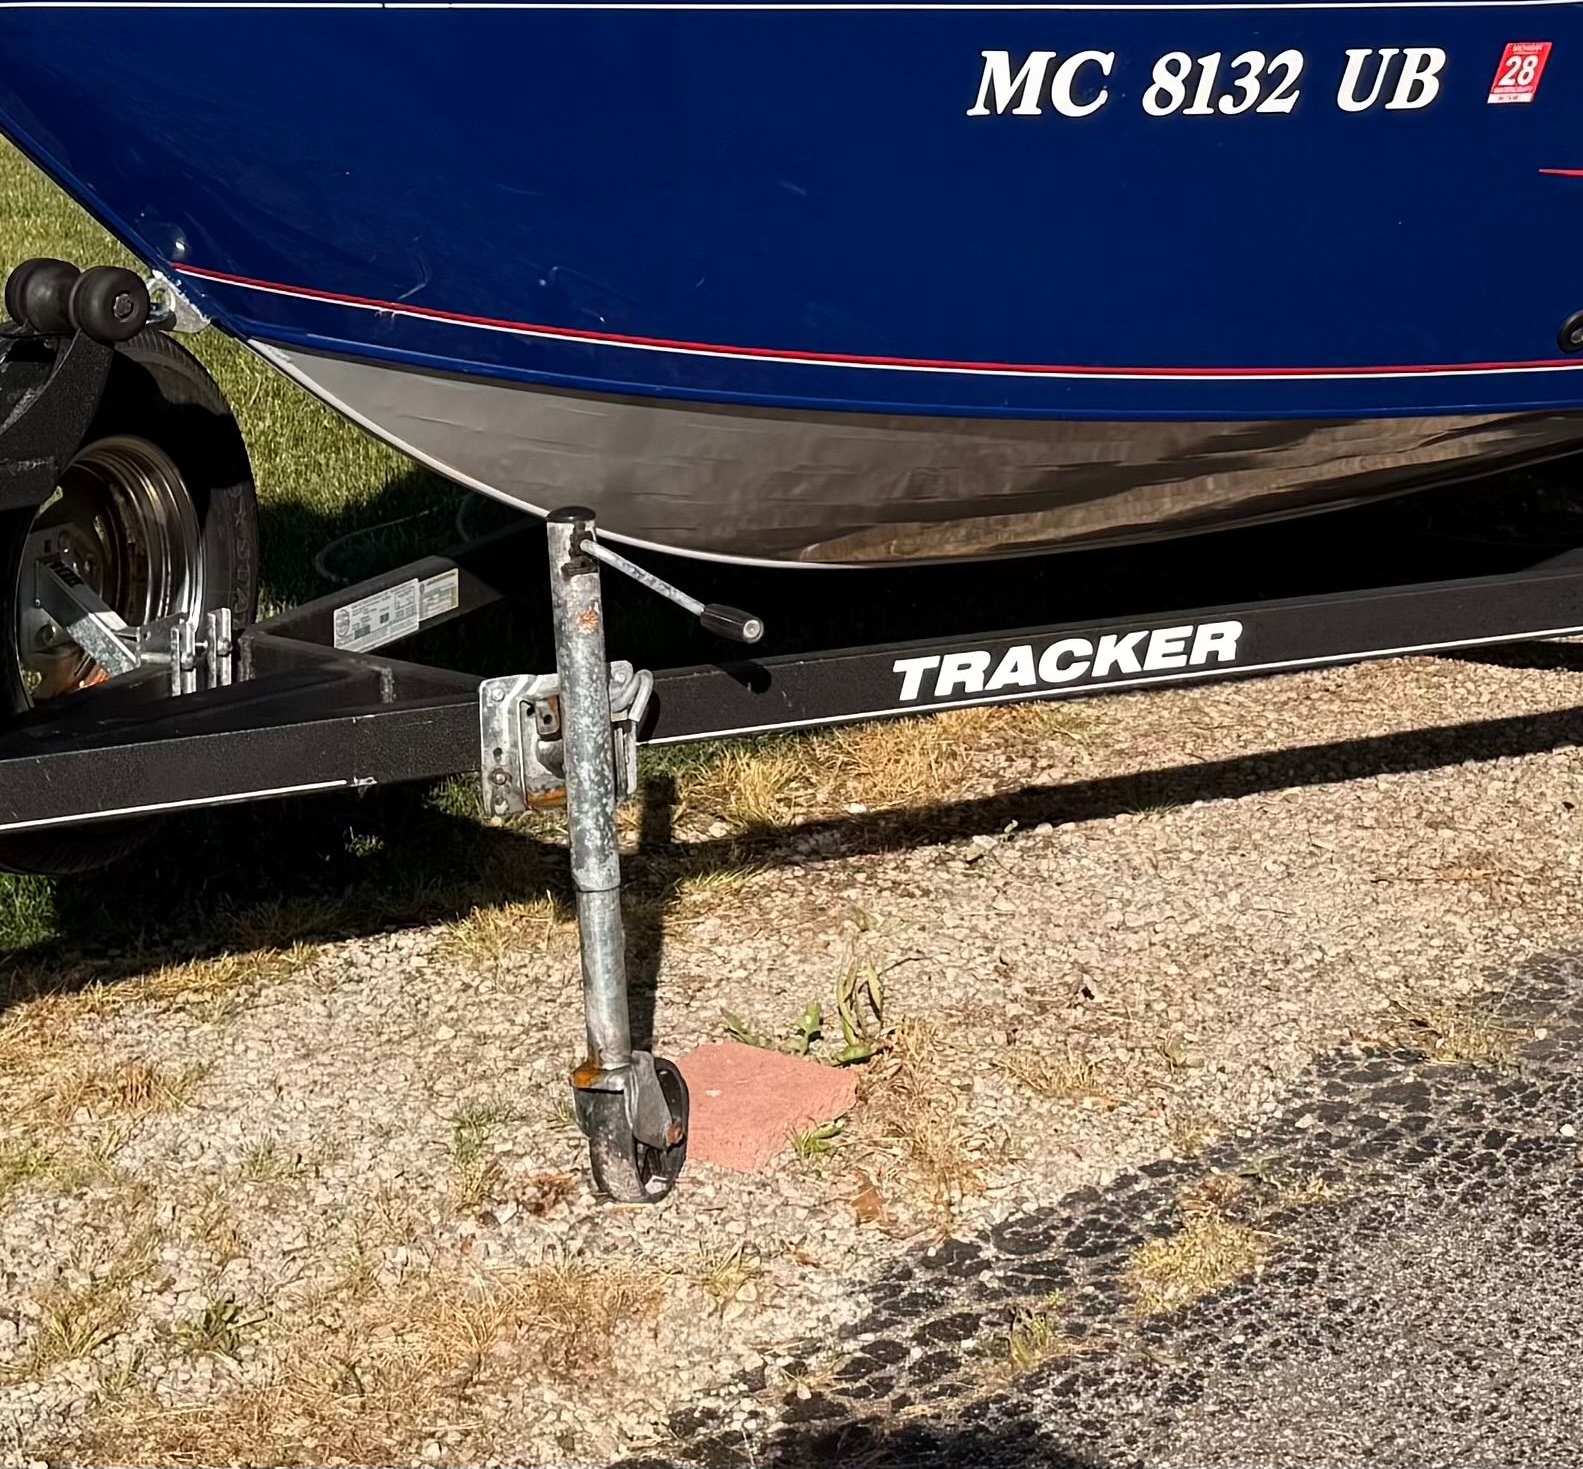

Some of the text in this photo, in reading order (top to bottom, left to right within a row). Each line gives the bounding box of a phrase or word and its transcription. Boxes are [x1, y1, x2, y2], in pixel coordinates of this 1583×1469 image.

[966, 47, 1446, 118] MC 8132 UB
[1498, 54, 1539, 87] 28
[892, 620, 1243, 701] TRACKER
